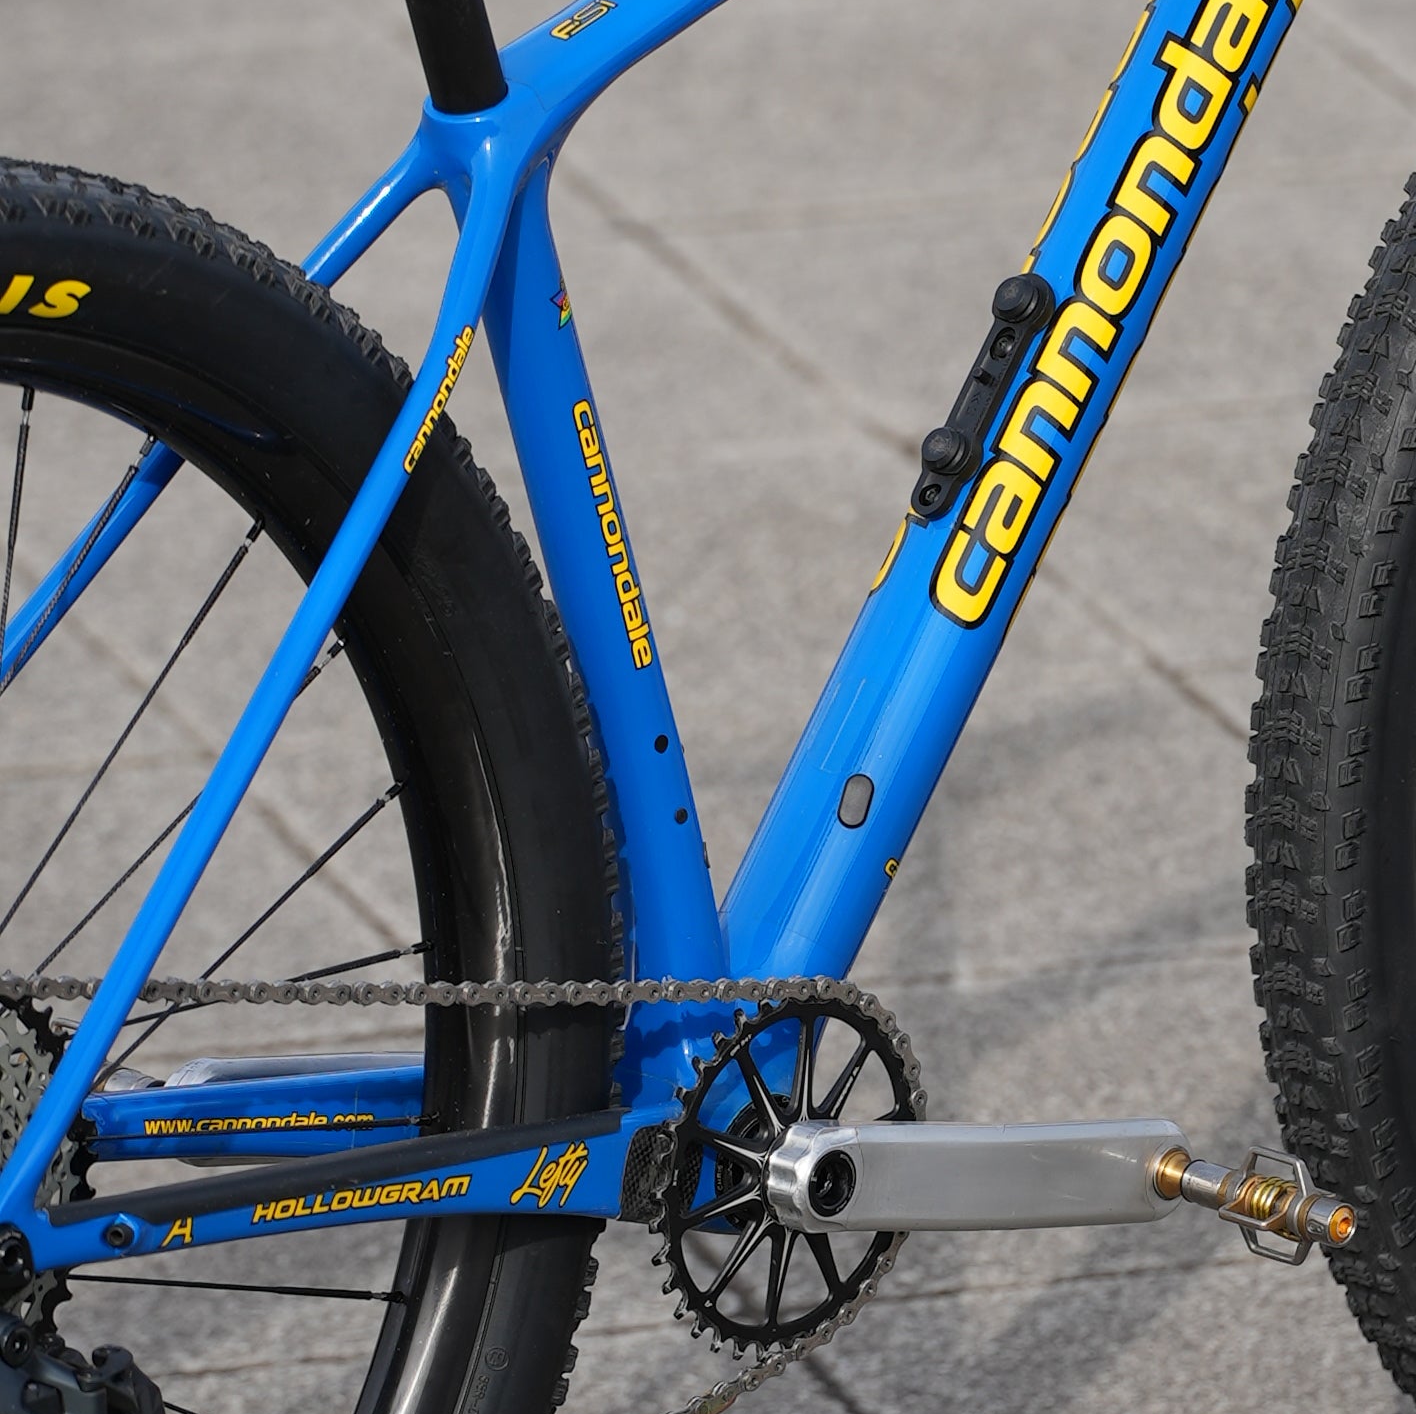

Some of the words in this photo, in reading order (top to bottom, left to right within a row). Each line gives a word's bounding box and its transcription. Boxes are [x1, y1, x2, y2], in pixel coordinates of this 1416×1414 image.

[404, 325, 475, 475] cannondale
[573, 399, 653, 670] cannondale
[144, 1110, 375, 1136] www.cannondalecom
[252, 1175, 473, 1224] HOLLOWGRAM
[511, 1140, 589, 1209] Lefty
